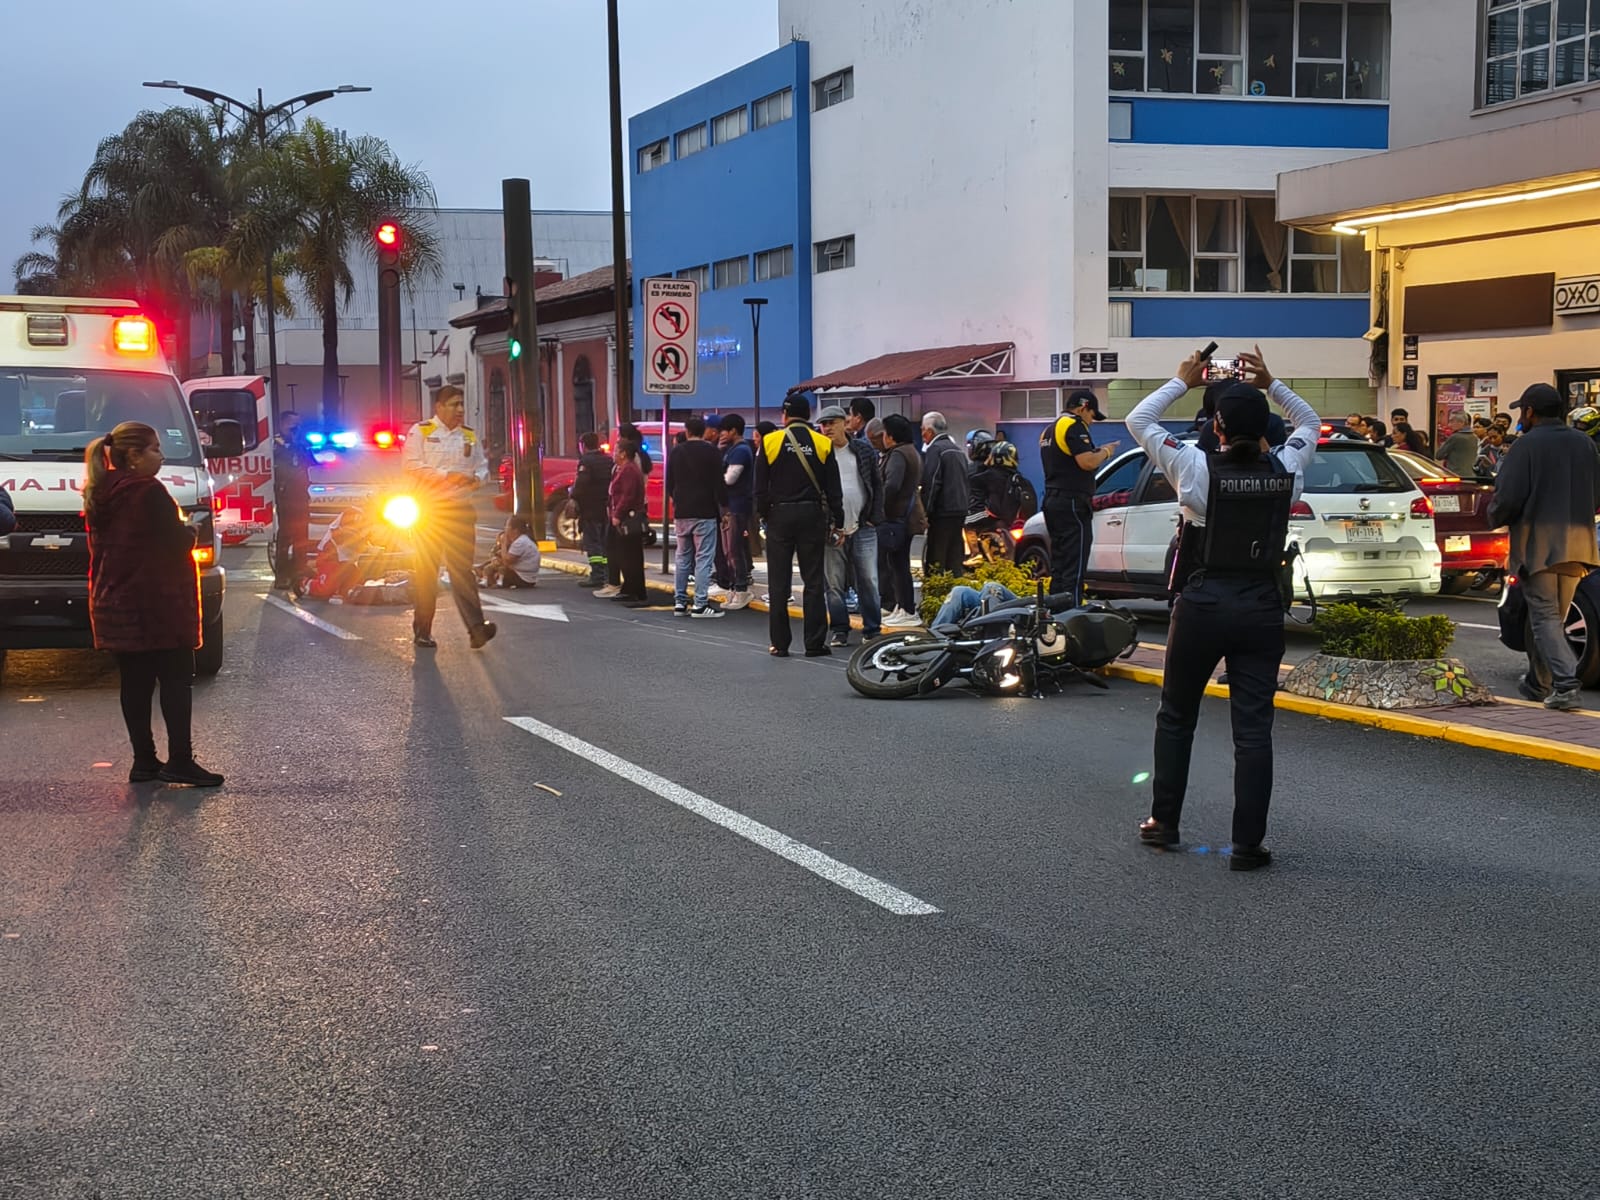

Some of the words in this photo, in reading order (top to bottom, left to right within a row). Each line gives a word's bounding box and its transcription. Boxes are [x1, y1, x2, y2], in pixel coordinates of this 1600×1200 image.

[661, 290, 692, 298] PRIMERO
[1556, 283, 1599, 308] OXXO
[787, 445, 813, 453] POCÍA
[207, 455, 272, 474] MBUL
[1220, 475, 1261, 492] POLICÍA
